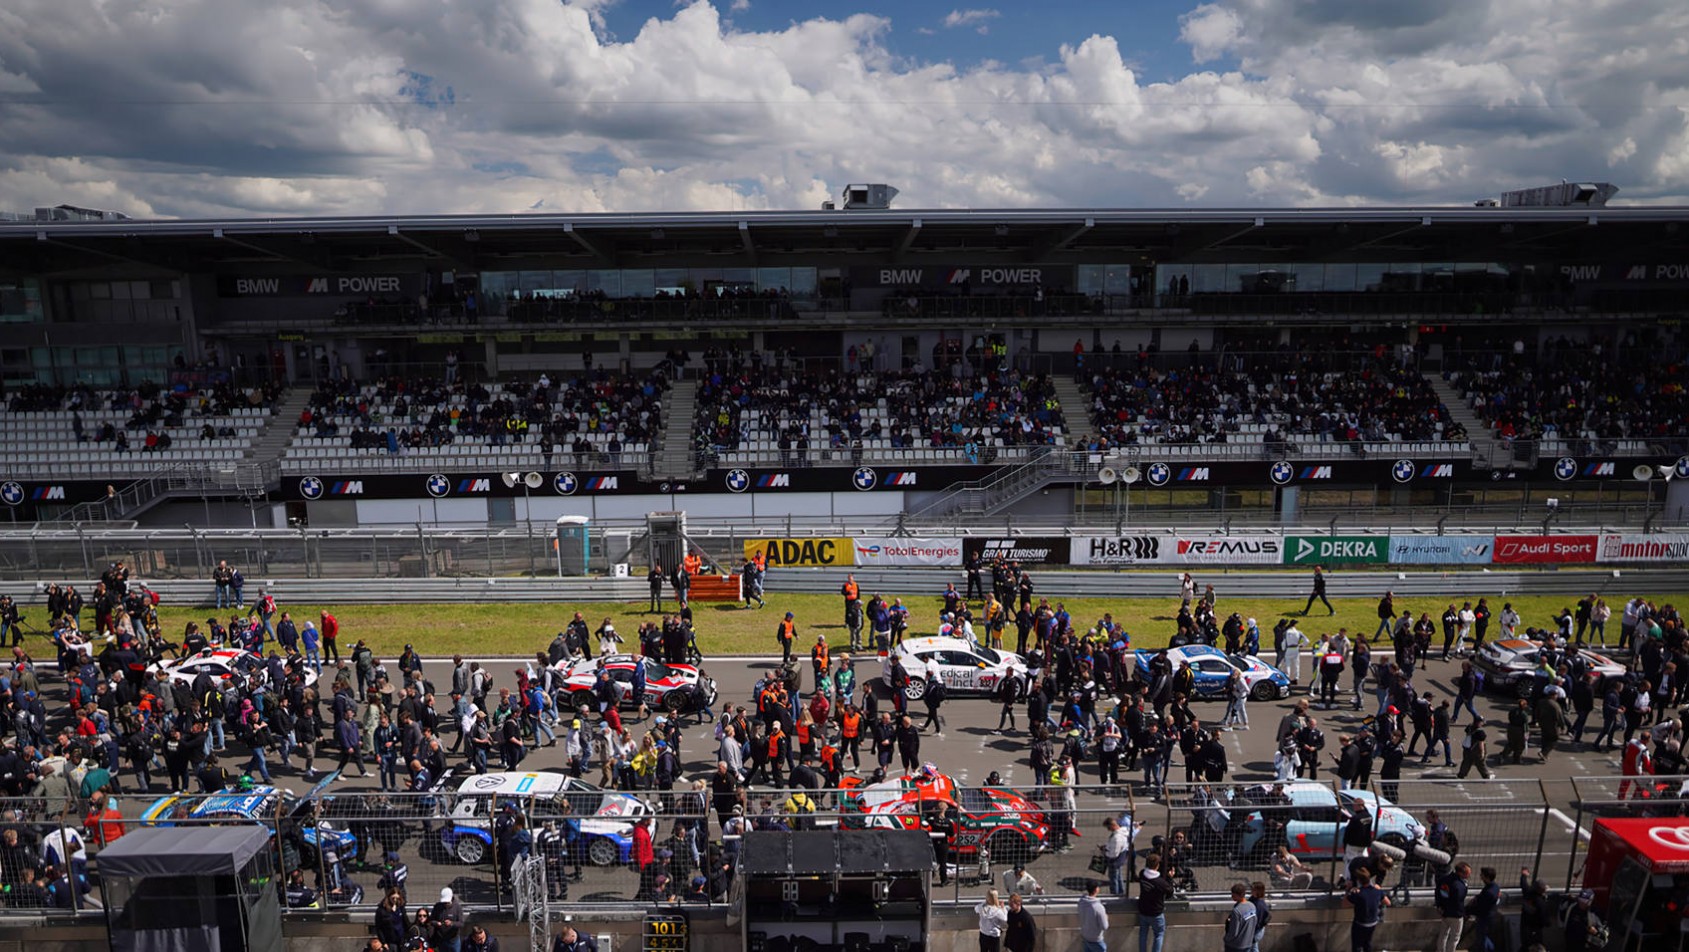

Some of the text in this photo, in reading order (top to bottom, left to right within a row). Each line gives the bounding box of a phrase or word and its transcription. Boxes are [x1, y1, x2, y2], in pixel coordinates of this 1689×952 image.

[880, 269, 923, 284] BMW
[981, 269, 1042, 284] POWER
[236, 278, 279, 293] BMW
[338, 276, 401, 292] POWER
[766, 540, 835, 564] ADAC
[883, 546, 959, 559] TotalEnergies
[982, 549, 1048, 558] GRAN TURISMO
[1090, 538, 1131, 556] H&R
[1188, 541, 1278, 554] REMUS
[1320, 541, 1378, 557] DEKRA
[1518, 543, 1592, 555] Audi Sport
[619, 565, 624, 573] 2
[941, 669, 973, 678] edical
[652, 922, 676, 934] 101
